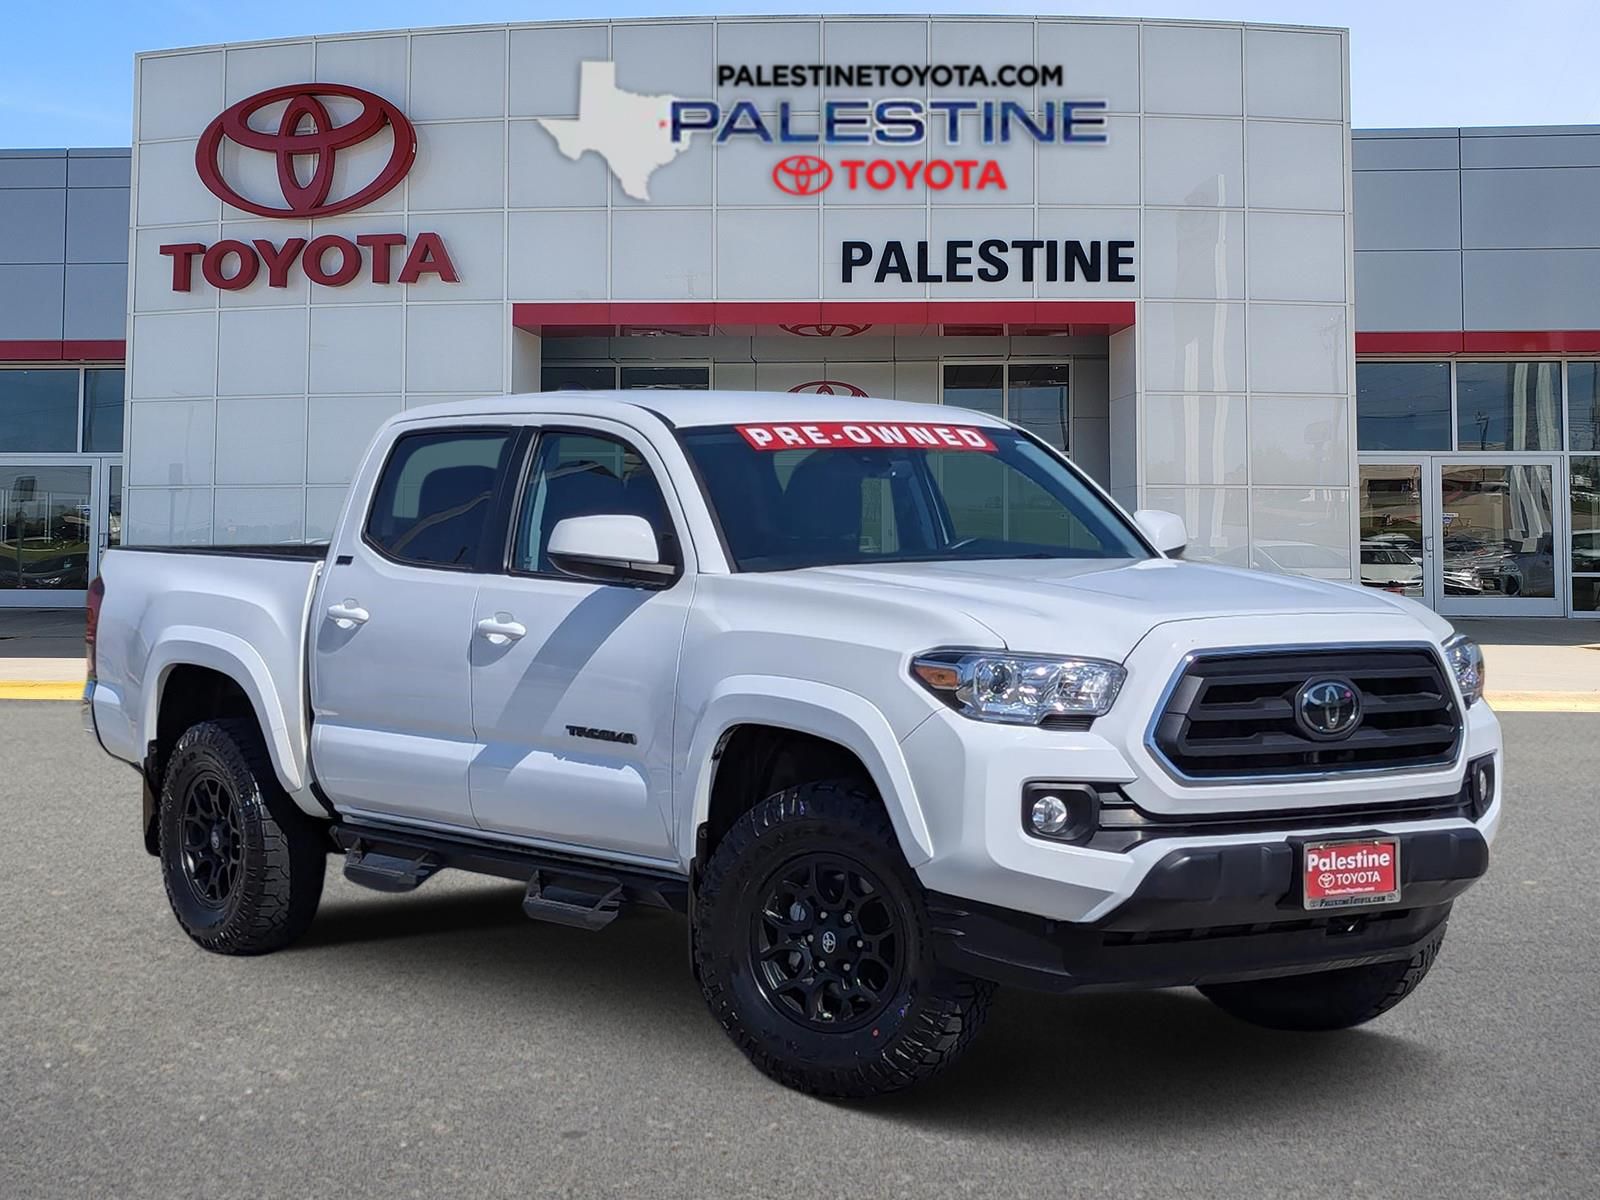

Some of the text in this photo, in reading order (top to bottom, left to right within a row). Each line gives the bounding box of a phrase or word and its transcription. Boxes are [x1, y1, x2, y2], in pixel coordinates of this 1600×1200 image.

[160, 232, 460, 292] TOYOTA
[841, 240, 1136, 284] PALESTINE
[746, 425, 987, 448] PRE-OWNED
[1307, 850, 1390, 872] Palestine
[1336, 871, 1381, 885] TOYOTA
